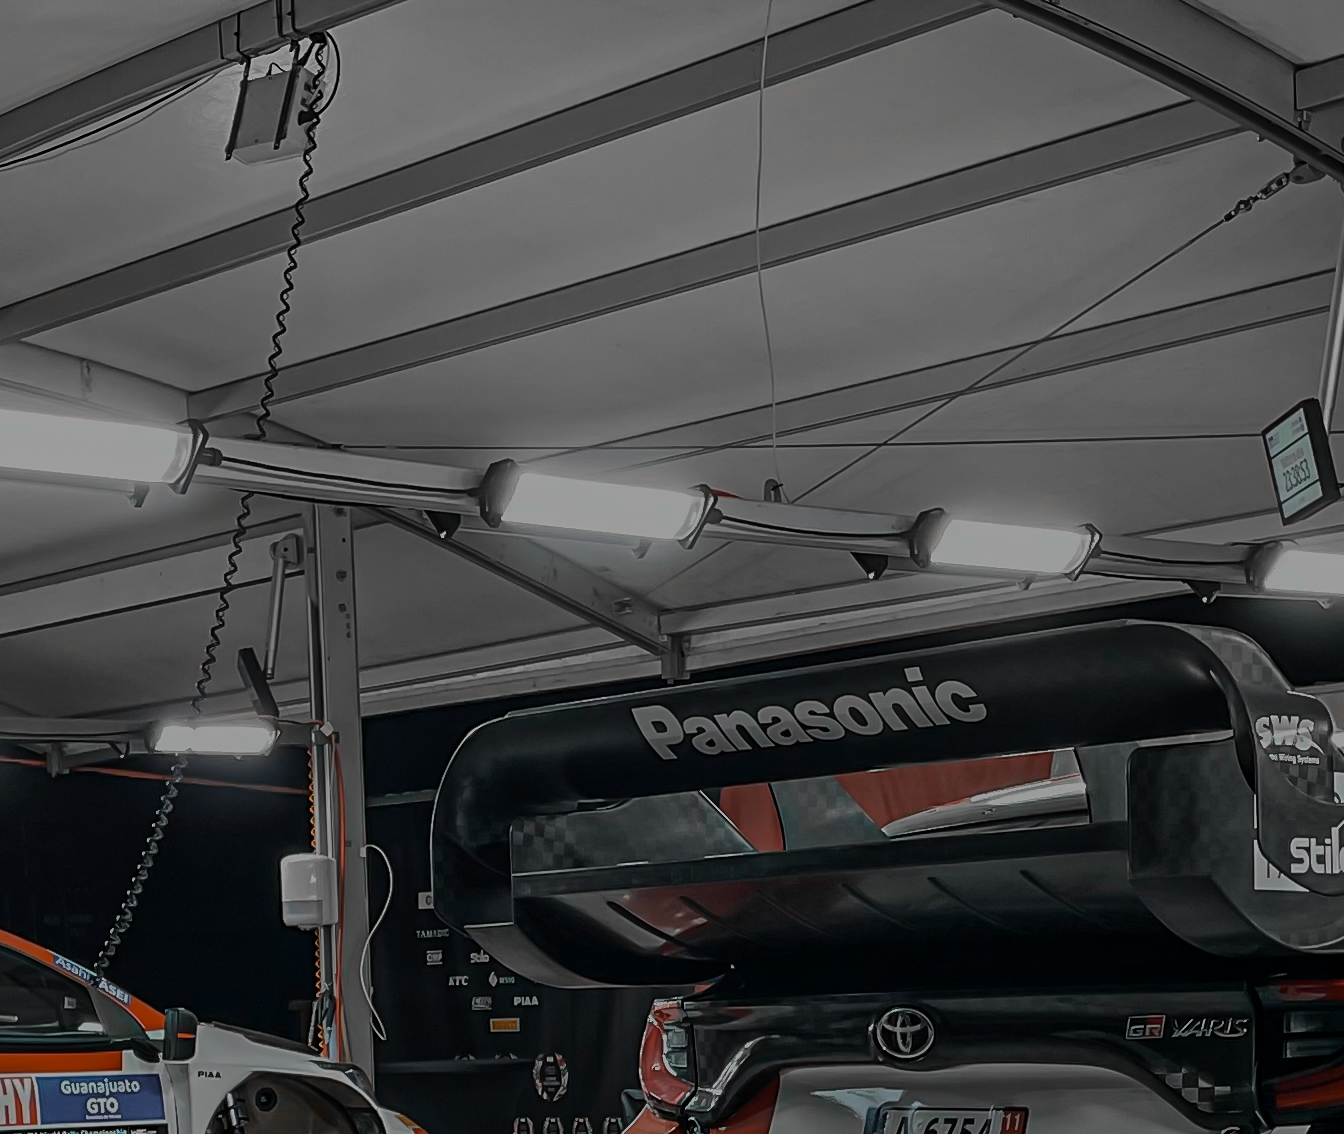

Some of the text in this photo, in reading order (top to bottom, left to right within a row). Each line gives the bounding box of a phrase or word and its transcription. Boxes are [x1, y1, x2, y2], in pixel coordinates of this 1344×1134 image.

[630, 666, 988, 761] Panasonic
[1256, 714, 1325, 756] SWS
[512, 995, 540, 1007] PIAA
[1128, 1016, 1251, 1040] GR YARIS
[197, 1070, 223, 1079] PIAA
[60, 1077, 141, 1097] Guanajuato
[85, 1096, 120, 1115] GTO
[1004, 1112, 1021, 1132] 11
